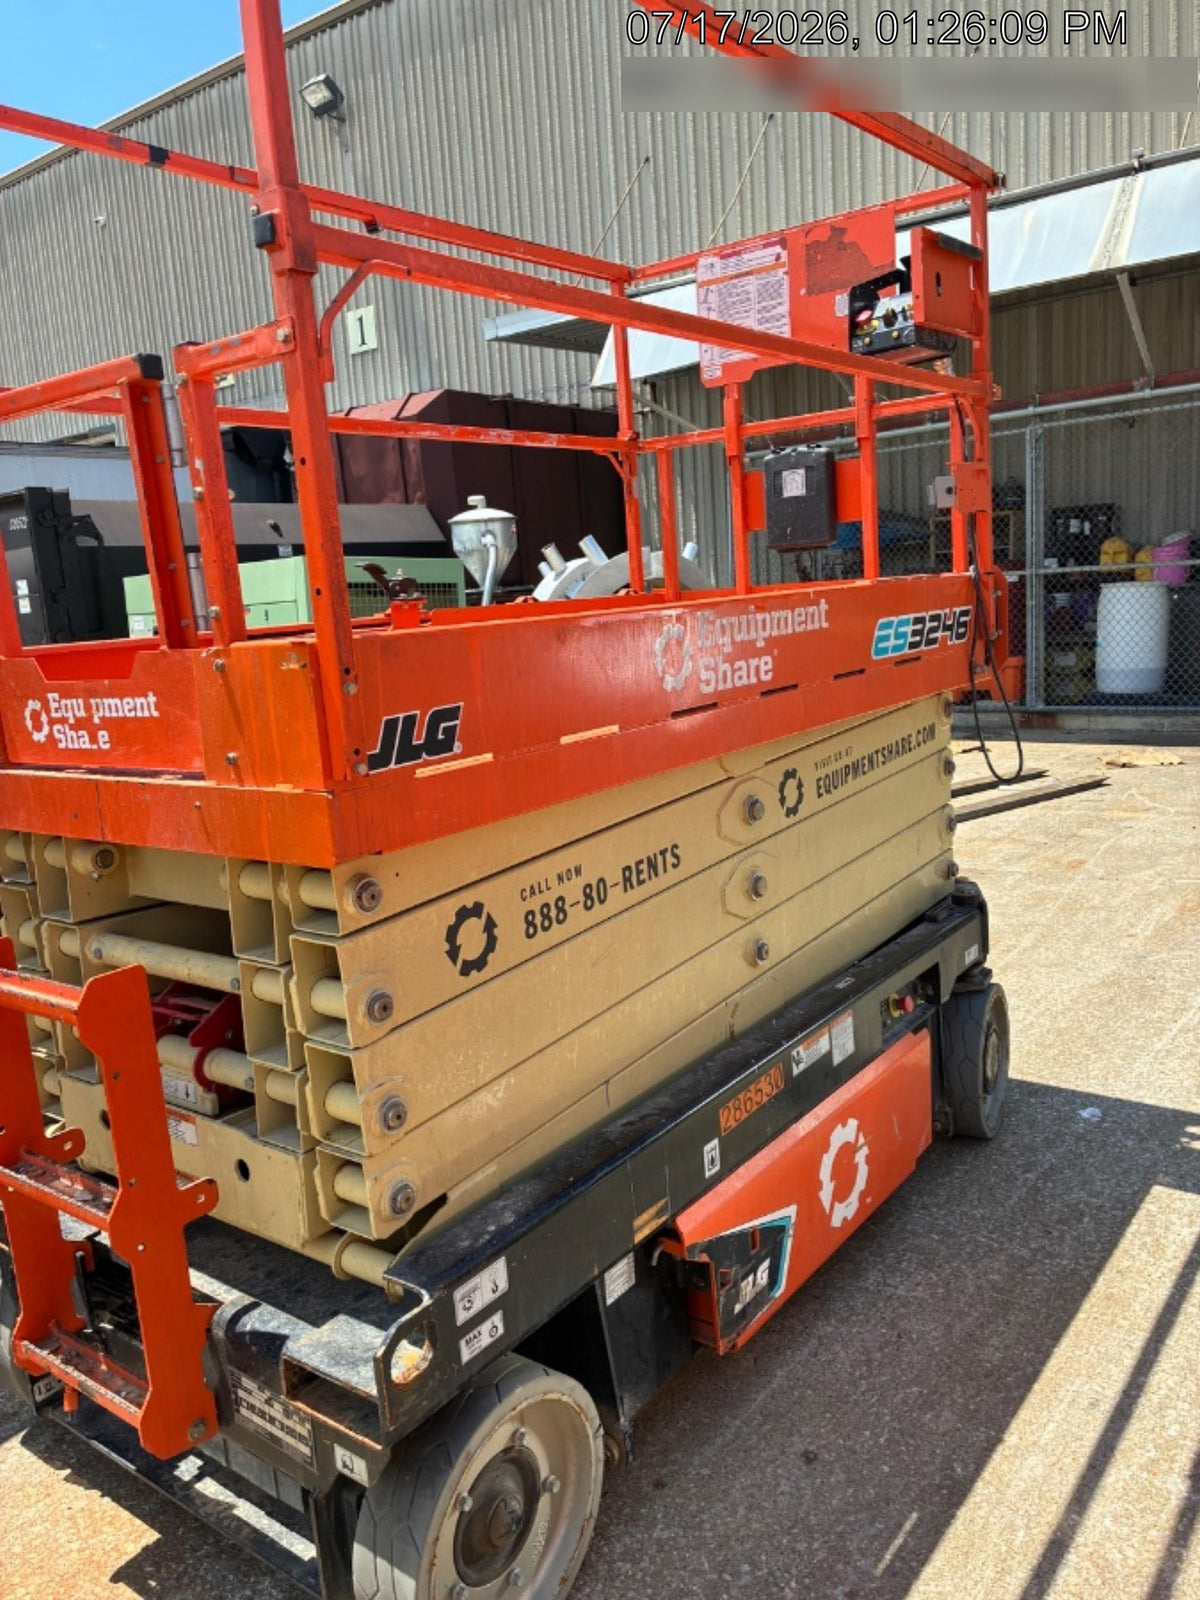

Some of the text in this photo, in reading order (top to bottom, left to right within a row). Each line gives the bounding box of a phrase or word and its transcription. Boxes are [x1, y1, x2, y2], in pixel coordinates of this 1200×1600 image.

[356, 314, 368, 347] 1
[697, 599, 830, 653] Equipment
[871, 605, 973, 660] ES3246
[700, 654, 773, 694] Share
[46, 691, 160, 724] Equpment
[52, 723, 111, 749] Shae
[366, 701, 464, 774] JLG
[816, 723, 936, 799] EQUIPMENTSHARE.COM
[520, 864, 582, 901] CALL NOW
[524, 843, 681, 939] 888-80-RENTS
[720, 1065, 784, 1132] 286530
[464, 1329, 483, 1346] MAX
